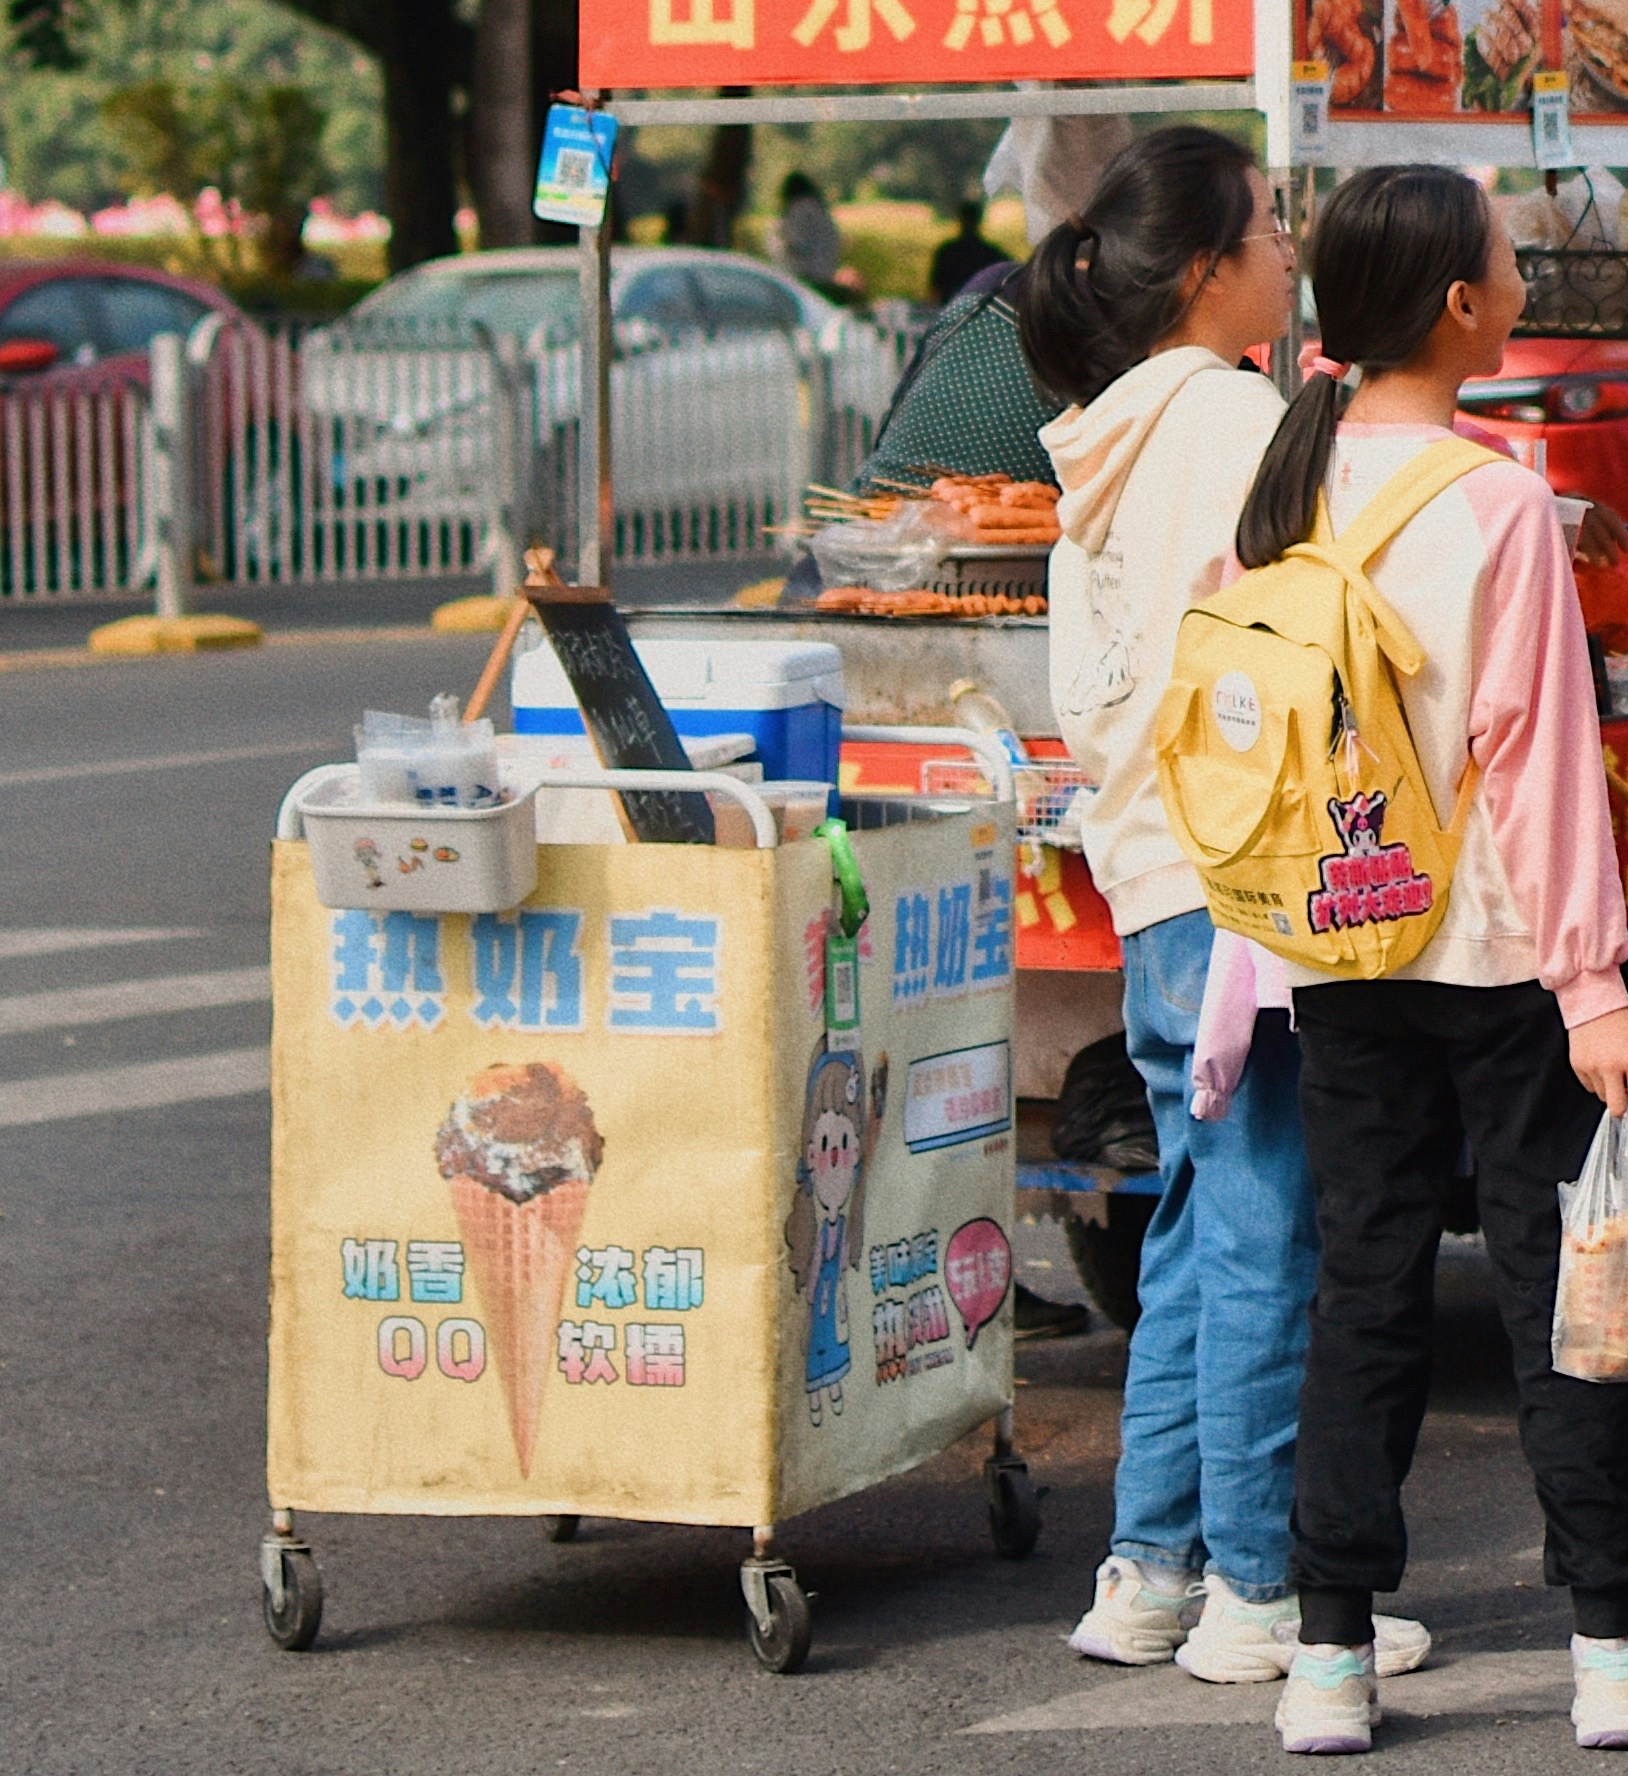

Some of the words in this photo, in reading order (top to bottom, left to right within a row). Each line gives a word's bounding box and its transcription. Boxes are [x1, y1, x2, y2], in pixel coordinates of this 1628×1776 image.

[333, 910, 718, 1029] 热奶宝
[341, 1238, 465, 1304] 奶香
[576, 1245, 705, 1311] 浓郁
[377, 1315, 487, 1384] QQ
[557, 1320, 687, 1387] 软糯
